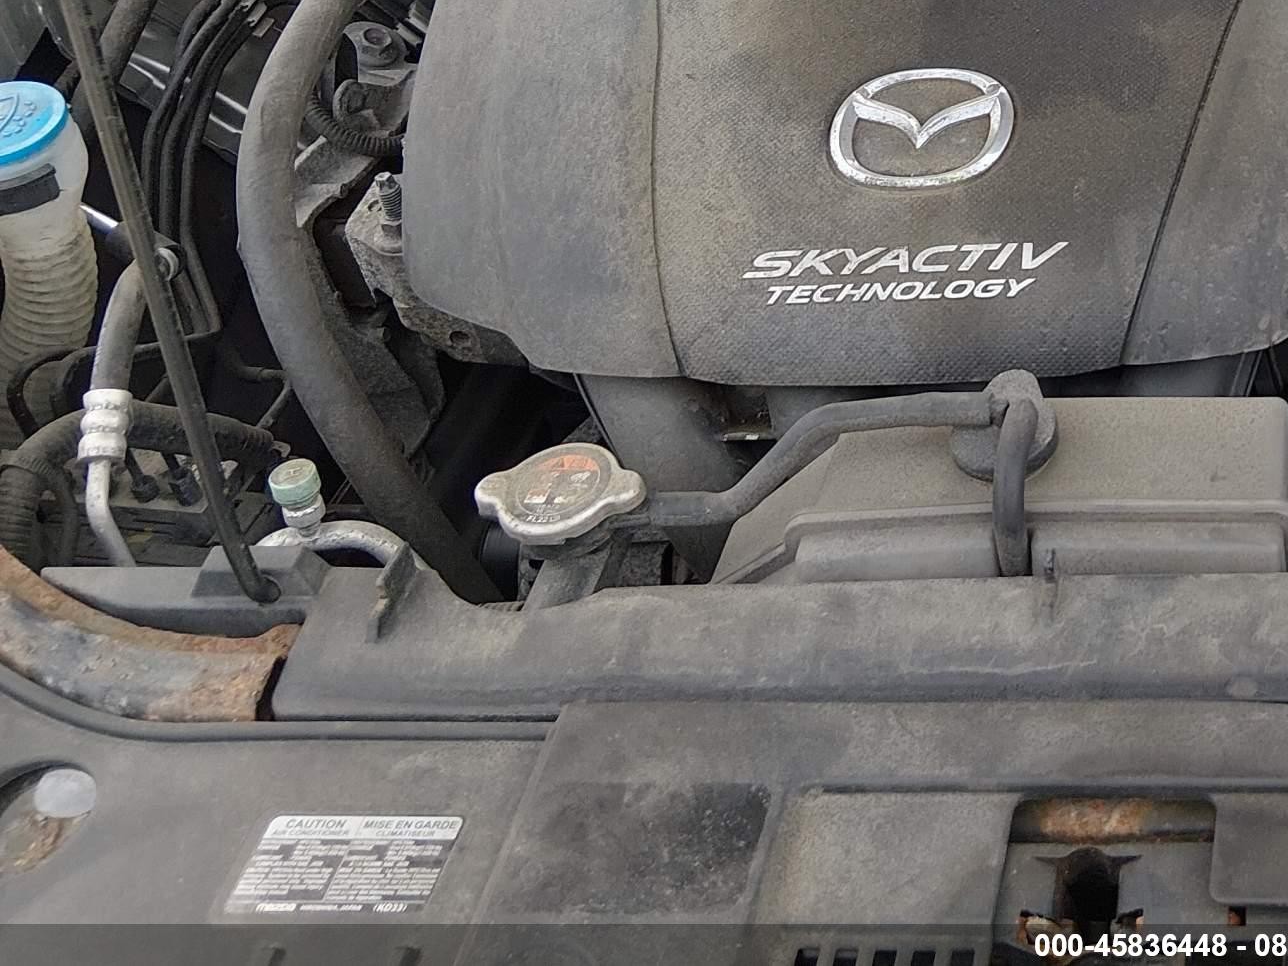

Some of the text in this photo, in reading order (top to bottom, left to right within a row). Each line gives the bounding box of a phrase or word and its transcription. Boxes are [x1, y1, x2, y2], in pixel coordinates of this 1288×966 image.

[742, 241, 1069, 279] SKYACTIV
[766, 278, 1036, 305] TECHNOLOGY
[286, 819, 347, 828] CAUTION
[363, 820, 458, 830] MISE EN GARDE
